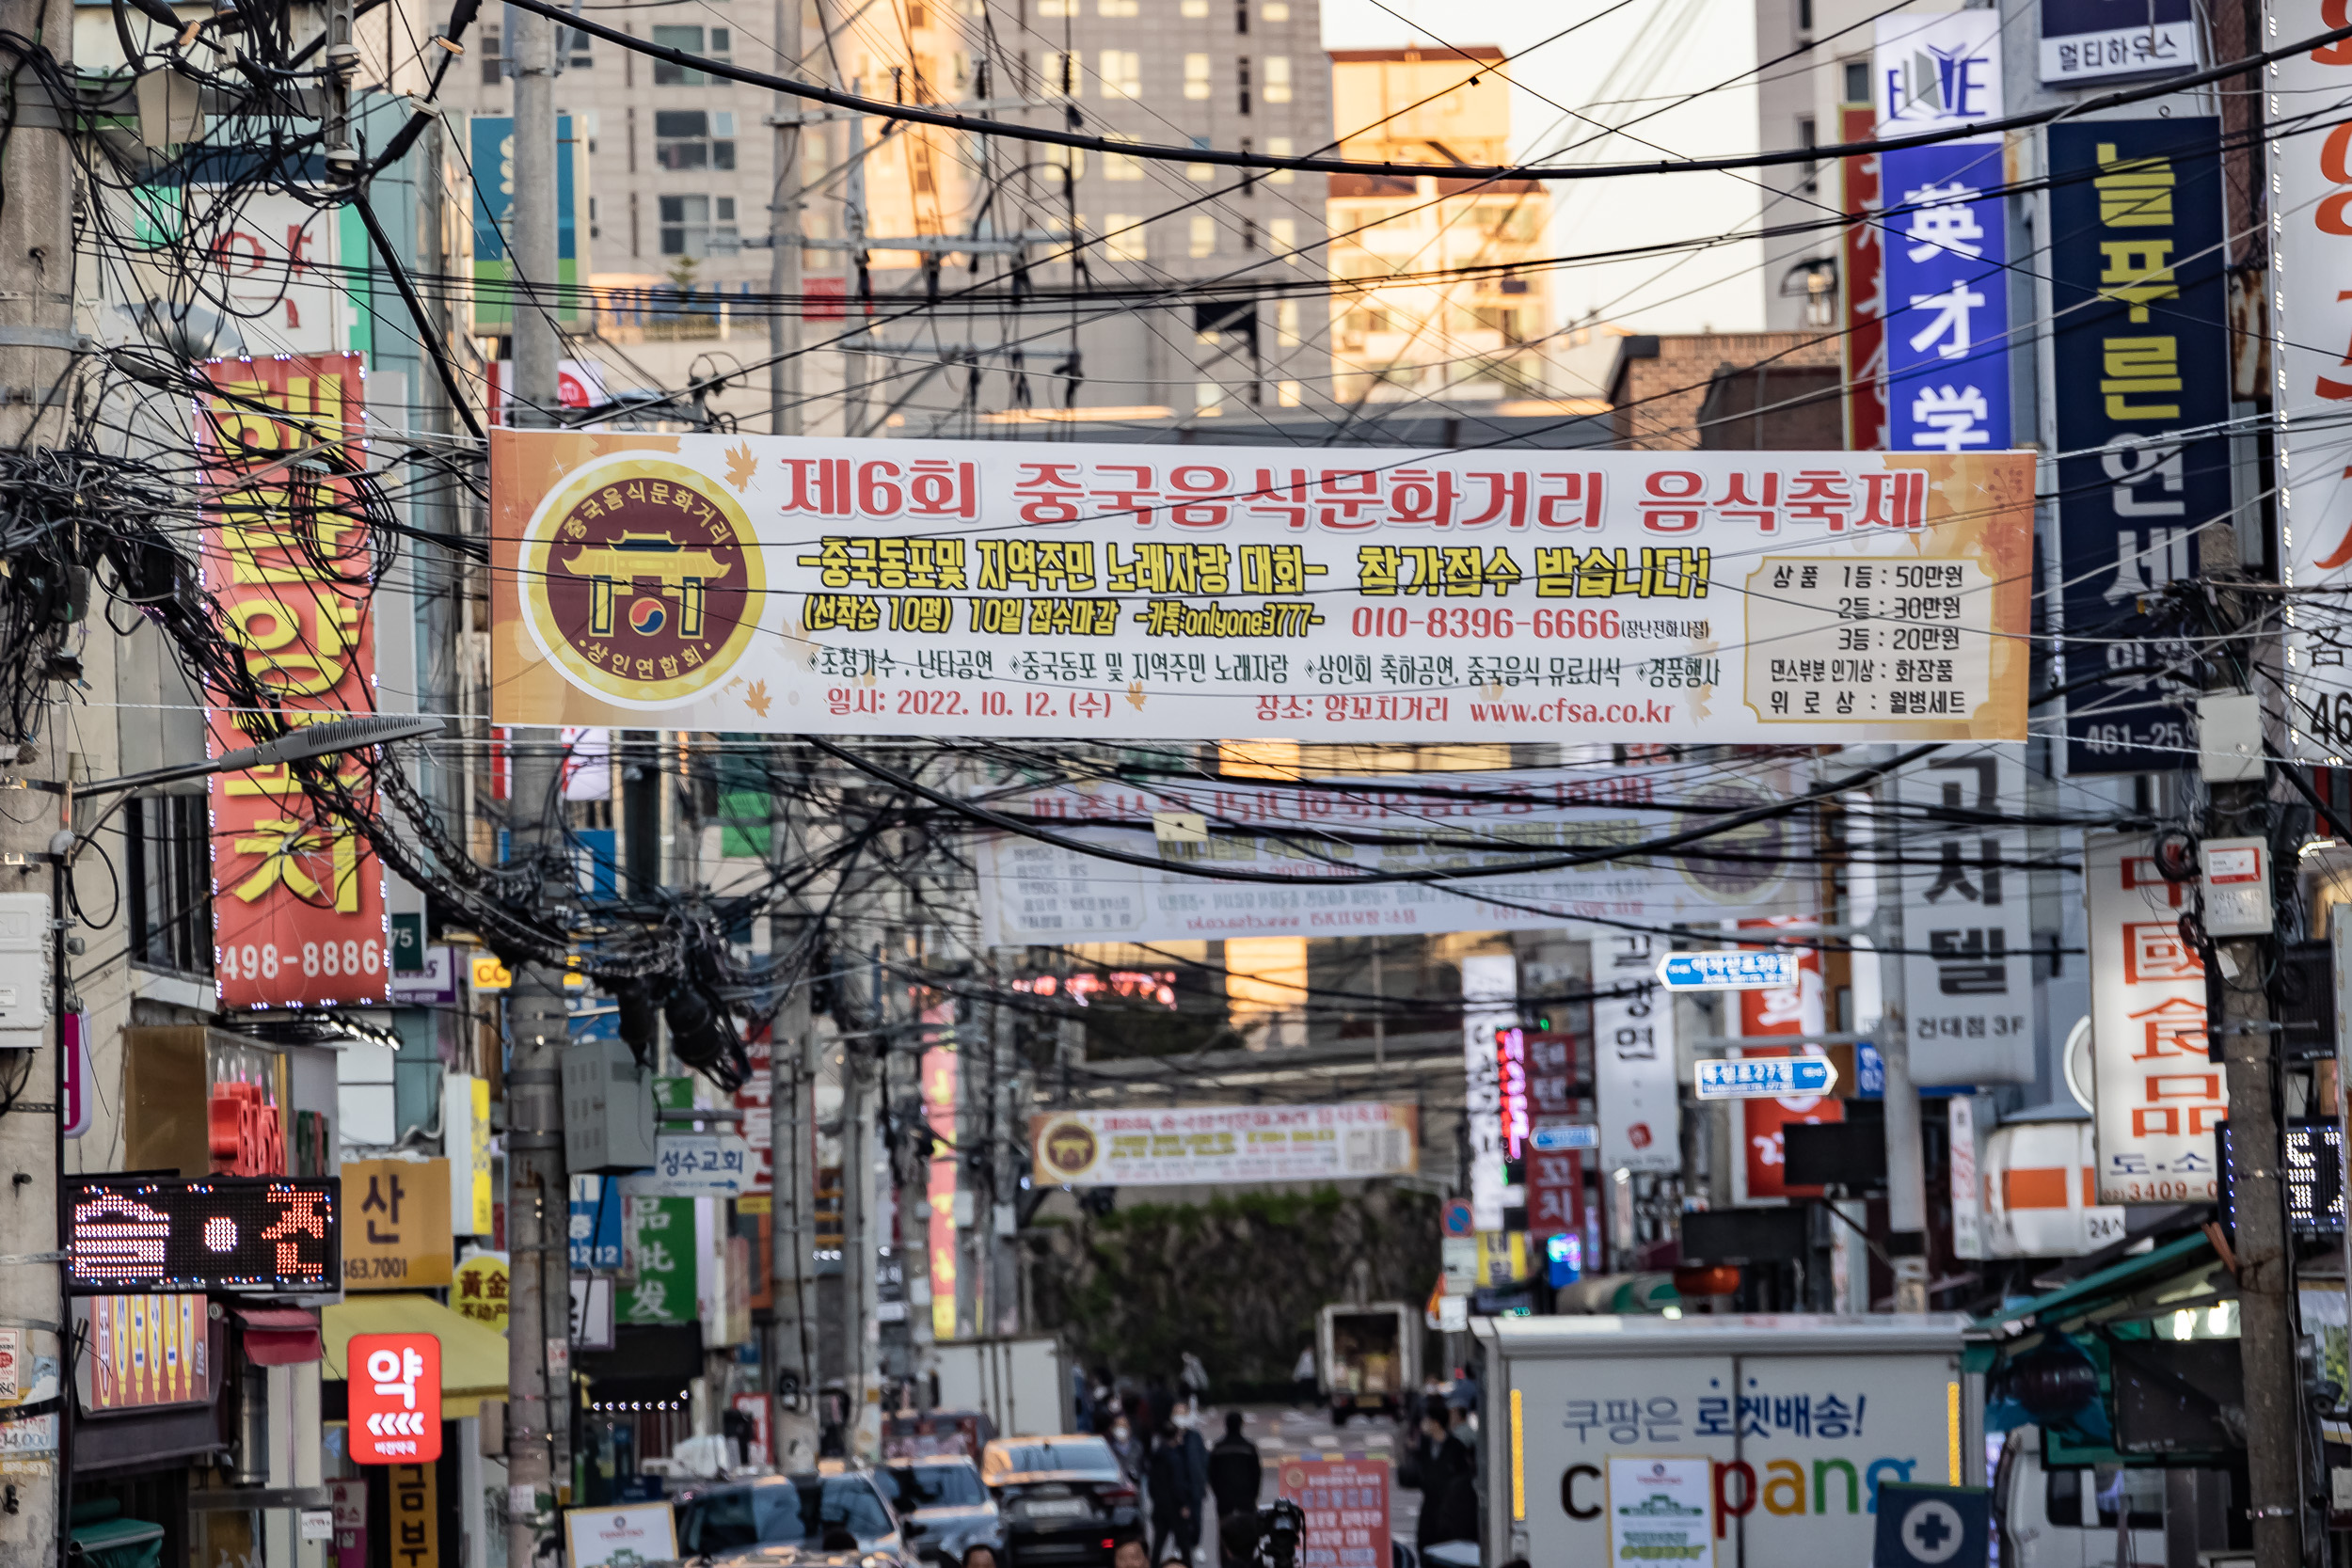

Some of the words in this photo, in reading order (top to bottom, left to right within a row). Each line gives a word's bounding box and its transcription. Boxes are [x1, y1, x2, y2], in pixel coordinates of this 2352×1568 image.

[2058, 31, 2178, 72] 멀티하우스
[1903, 182, 1991, 451] 英才学
[563, 480, 733, 546] 중국음식문화거리
[780, 457, 977, 518] 제6회
[1012, 462, 1603, 530] 중국음식문화거리
[1636, 468, 1924, 531] 음식축제
[976, 539, 1097, 592] 지역주민
[1106, 542, 1232, 594] 노래자랑
[1358, 545, 1523, 597] 참가접수
[1534, 546, 1711, 600] 받습니다!
[1895, 564, 1963, 589] 50만원
[803, 596, 882, 632] (선착순
[889, 597, 953, 633] 10명)
[969, 598, 1024, 634] 10일
[1029, 599, 1121, 636] 접수마감
[1351, 607, 1620, 641] 010-8396-6666
[1893, 596, 1961, 620] 30만원
[1892, 627, 1960, 651] 20만원
[586, 641, 705, 680] 상인연합회
[918, 648, 993, 680] 난타공연
[1021, 651, 1098, 680] 중국동포
[1105, 651, 1124, 682] 및
[1132, 653, 1207, 682] 지역주민
[1214, 654, 1289, 685] 노래자랑
[1317, 655, 1372, 685] 상인회
[1467, 656, 1540, 688] 중국음식
[1648, 657, 1722, 688] 경품행사
[1831, 658, 1875, 683] 인기상
[1895, 658, 1953, 683] 화장품
[827, 688, 886, 717] 일시:
[896, 689, 969, 717] 2022.
[981, 690, 1013, 717] 10.
[1025, 691, 1057, 718] 12.
[1069, 692, 1112, 719] (수)
[1254, 694, 1314, 721] 장소:
[1325, 694, 1449, 722] 양꼬치거리
[1470, 697, 1676, 723] www.cfsa.co.kr
[1889, 690, 1965, 714] 월병세트
[220, 939, 380, 980] 498-8886
[660, 1149, 744, 1177] 성수교회
[360, 1173, 405, 1244] 산
[366, 1347, 423, 1410] 약
[1563, 1396, 1683, 1445] 쿠팡은
[1693, 1392, 1867, 1439] 로켓배송!
[1560, 1457, 1917, 1539] cpan
